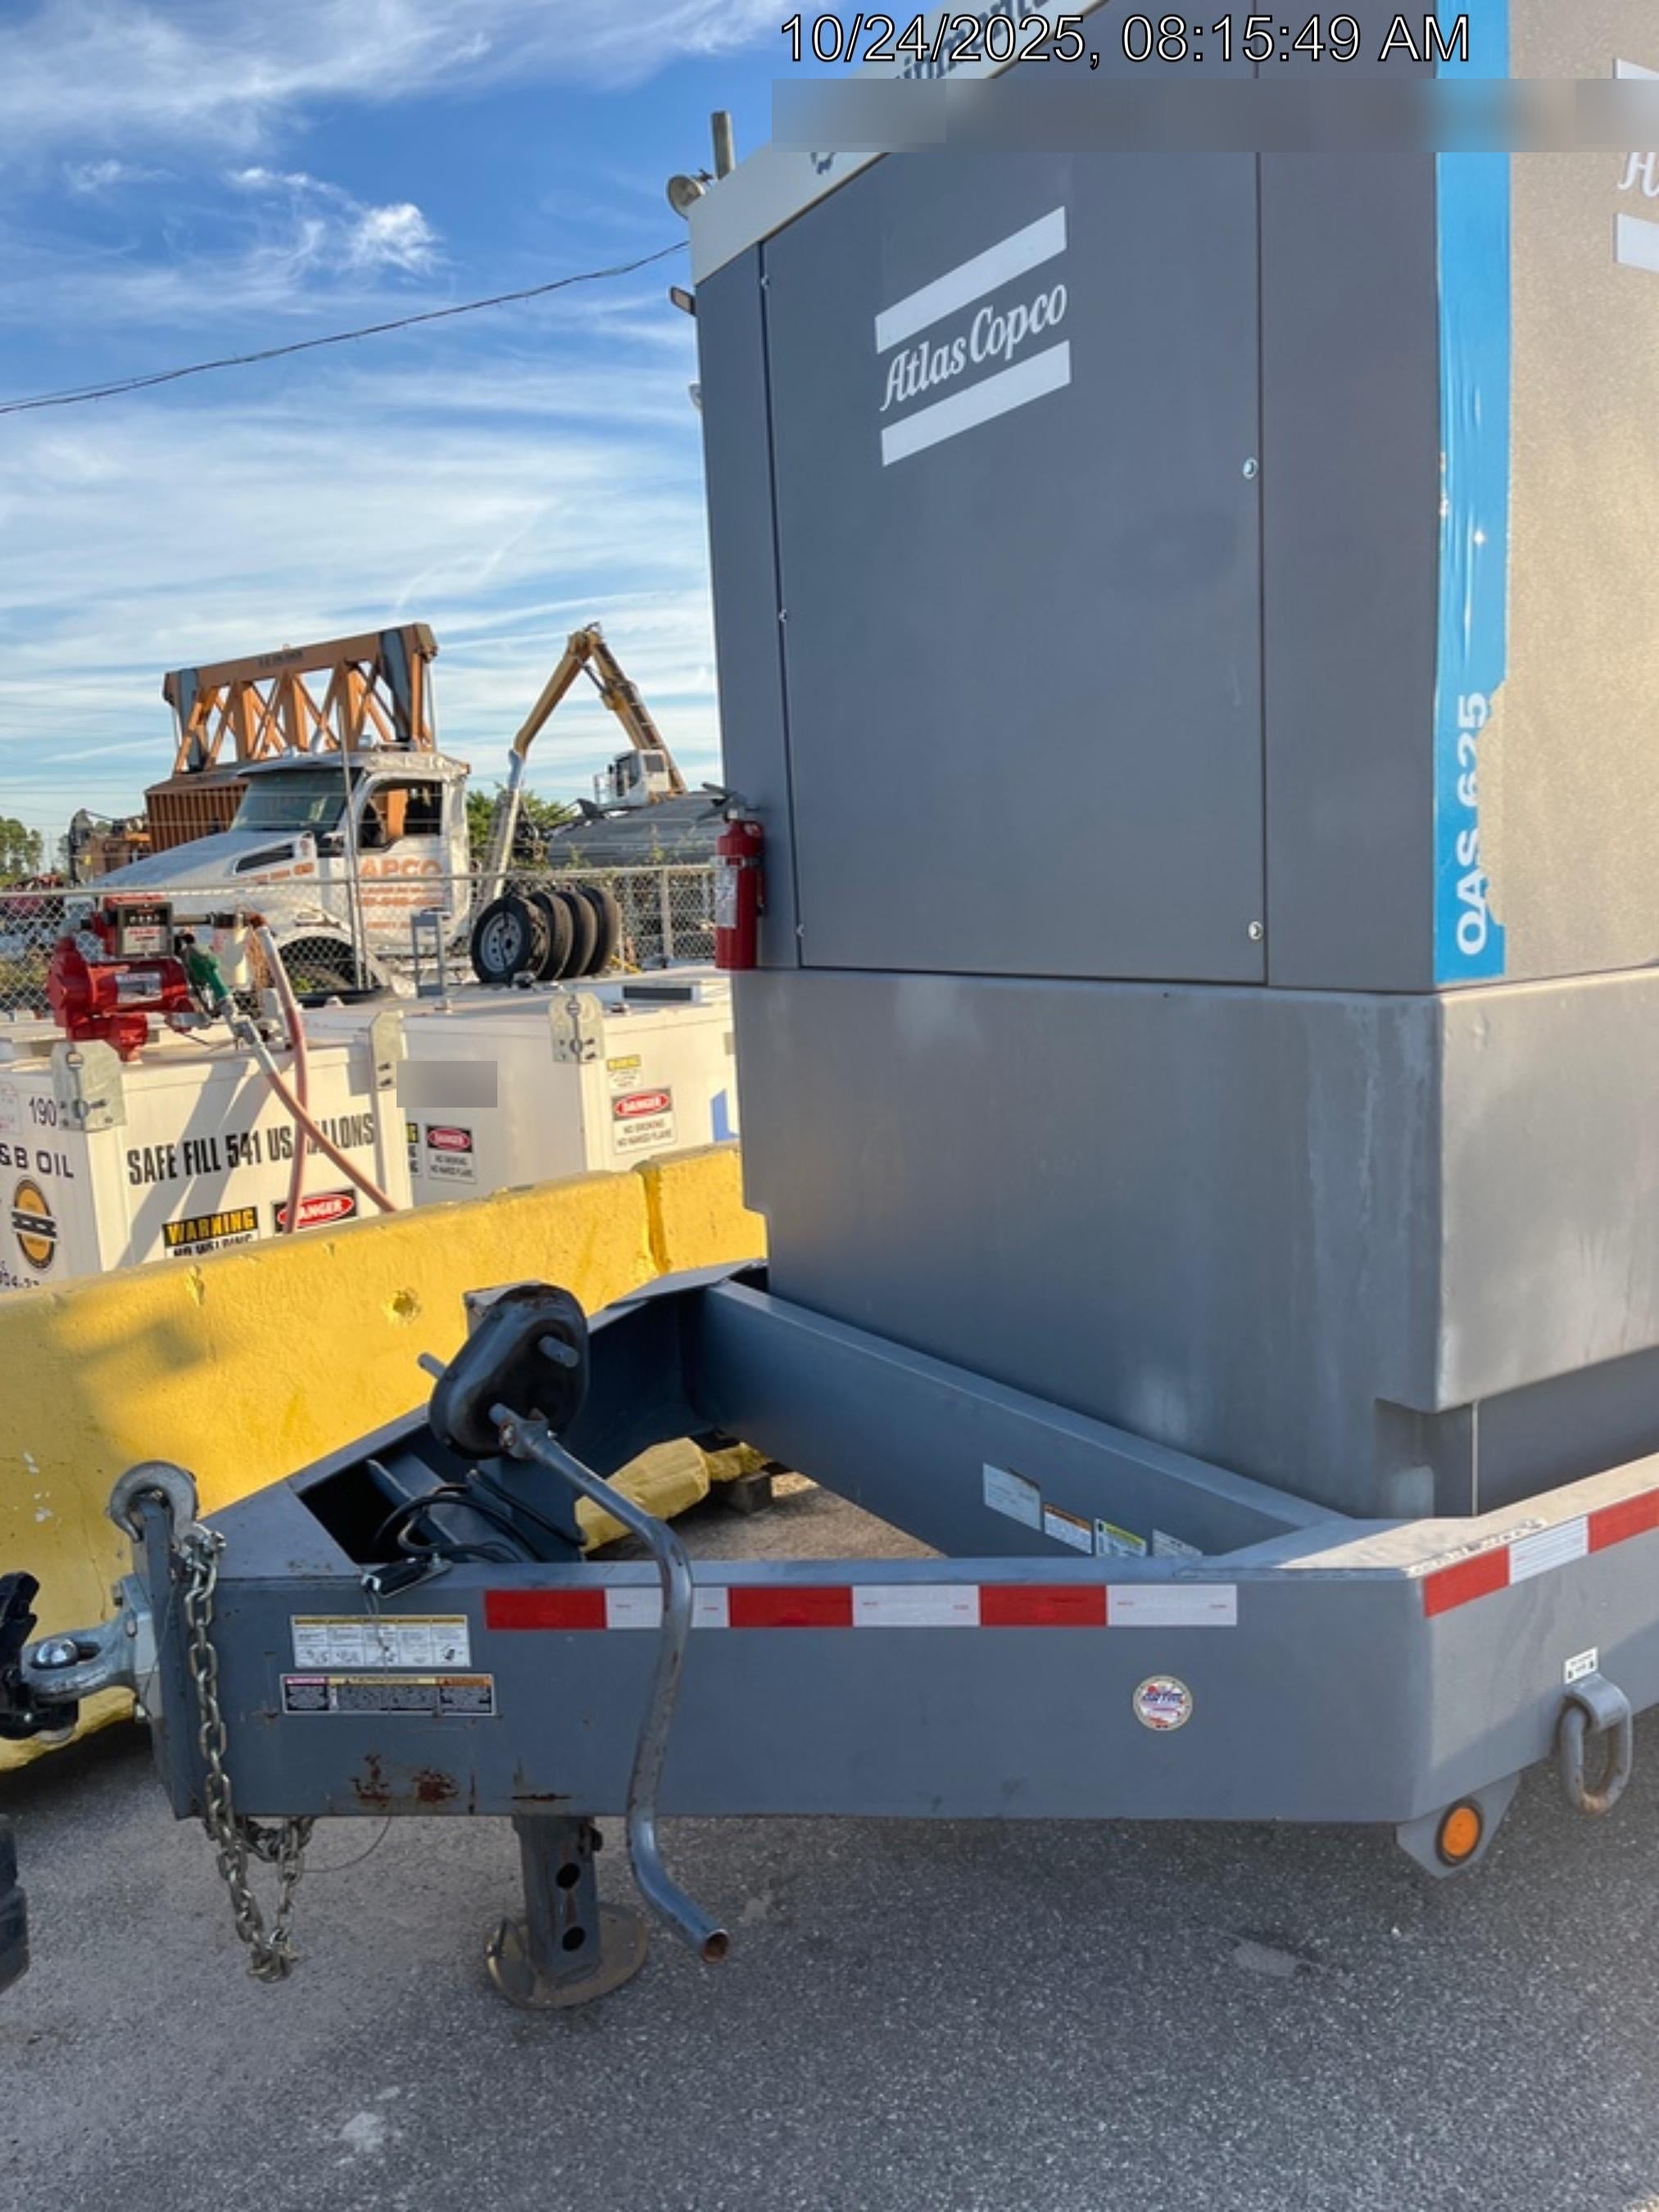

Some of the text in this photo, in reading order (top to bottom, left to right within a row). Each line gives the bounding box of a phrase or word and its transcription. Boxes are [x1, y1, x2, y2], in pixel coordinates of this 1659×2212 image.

[880, 283, 1068, 411] Atlas Copco
[1456, 827, 1489, 956] QAS
[37, 1149, 75, 1178] OIL
[127, 1144, 178, 1185] SAFE
[183, 1137, 222, 1176] FILL
[225, 1130, 261, 1168] 541
[267, 1126, 293, 1162] US
[166, 1208, 255, 1244] WARNING
[297, 1199, 342, 1221] ANGER
